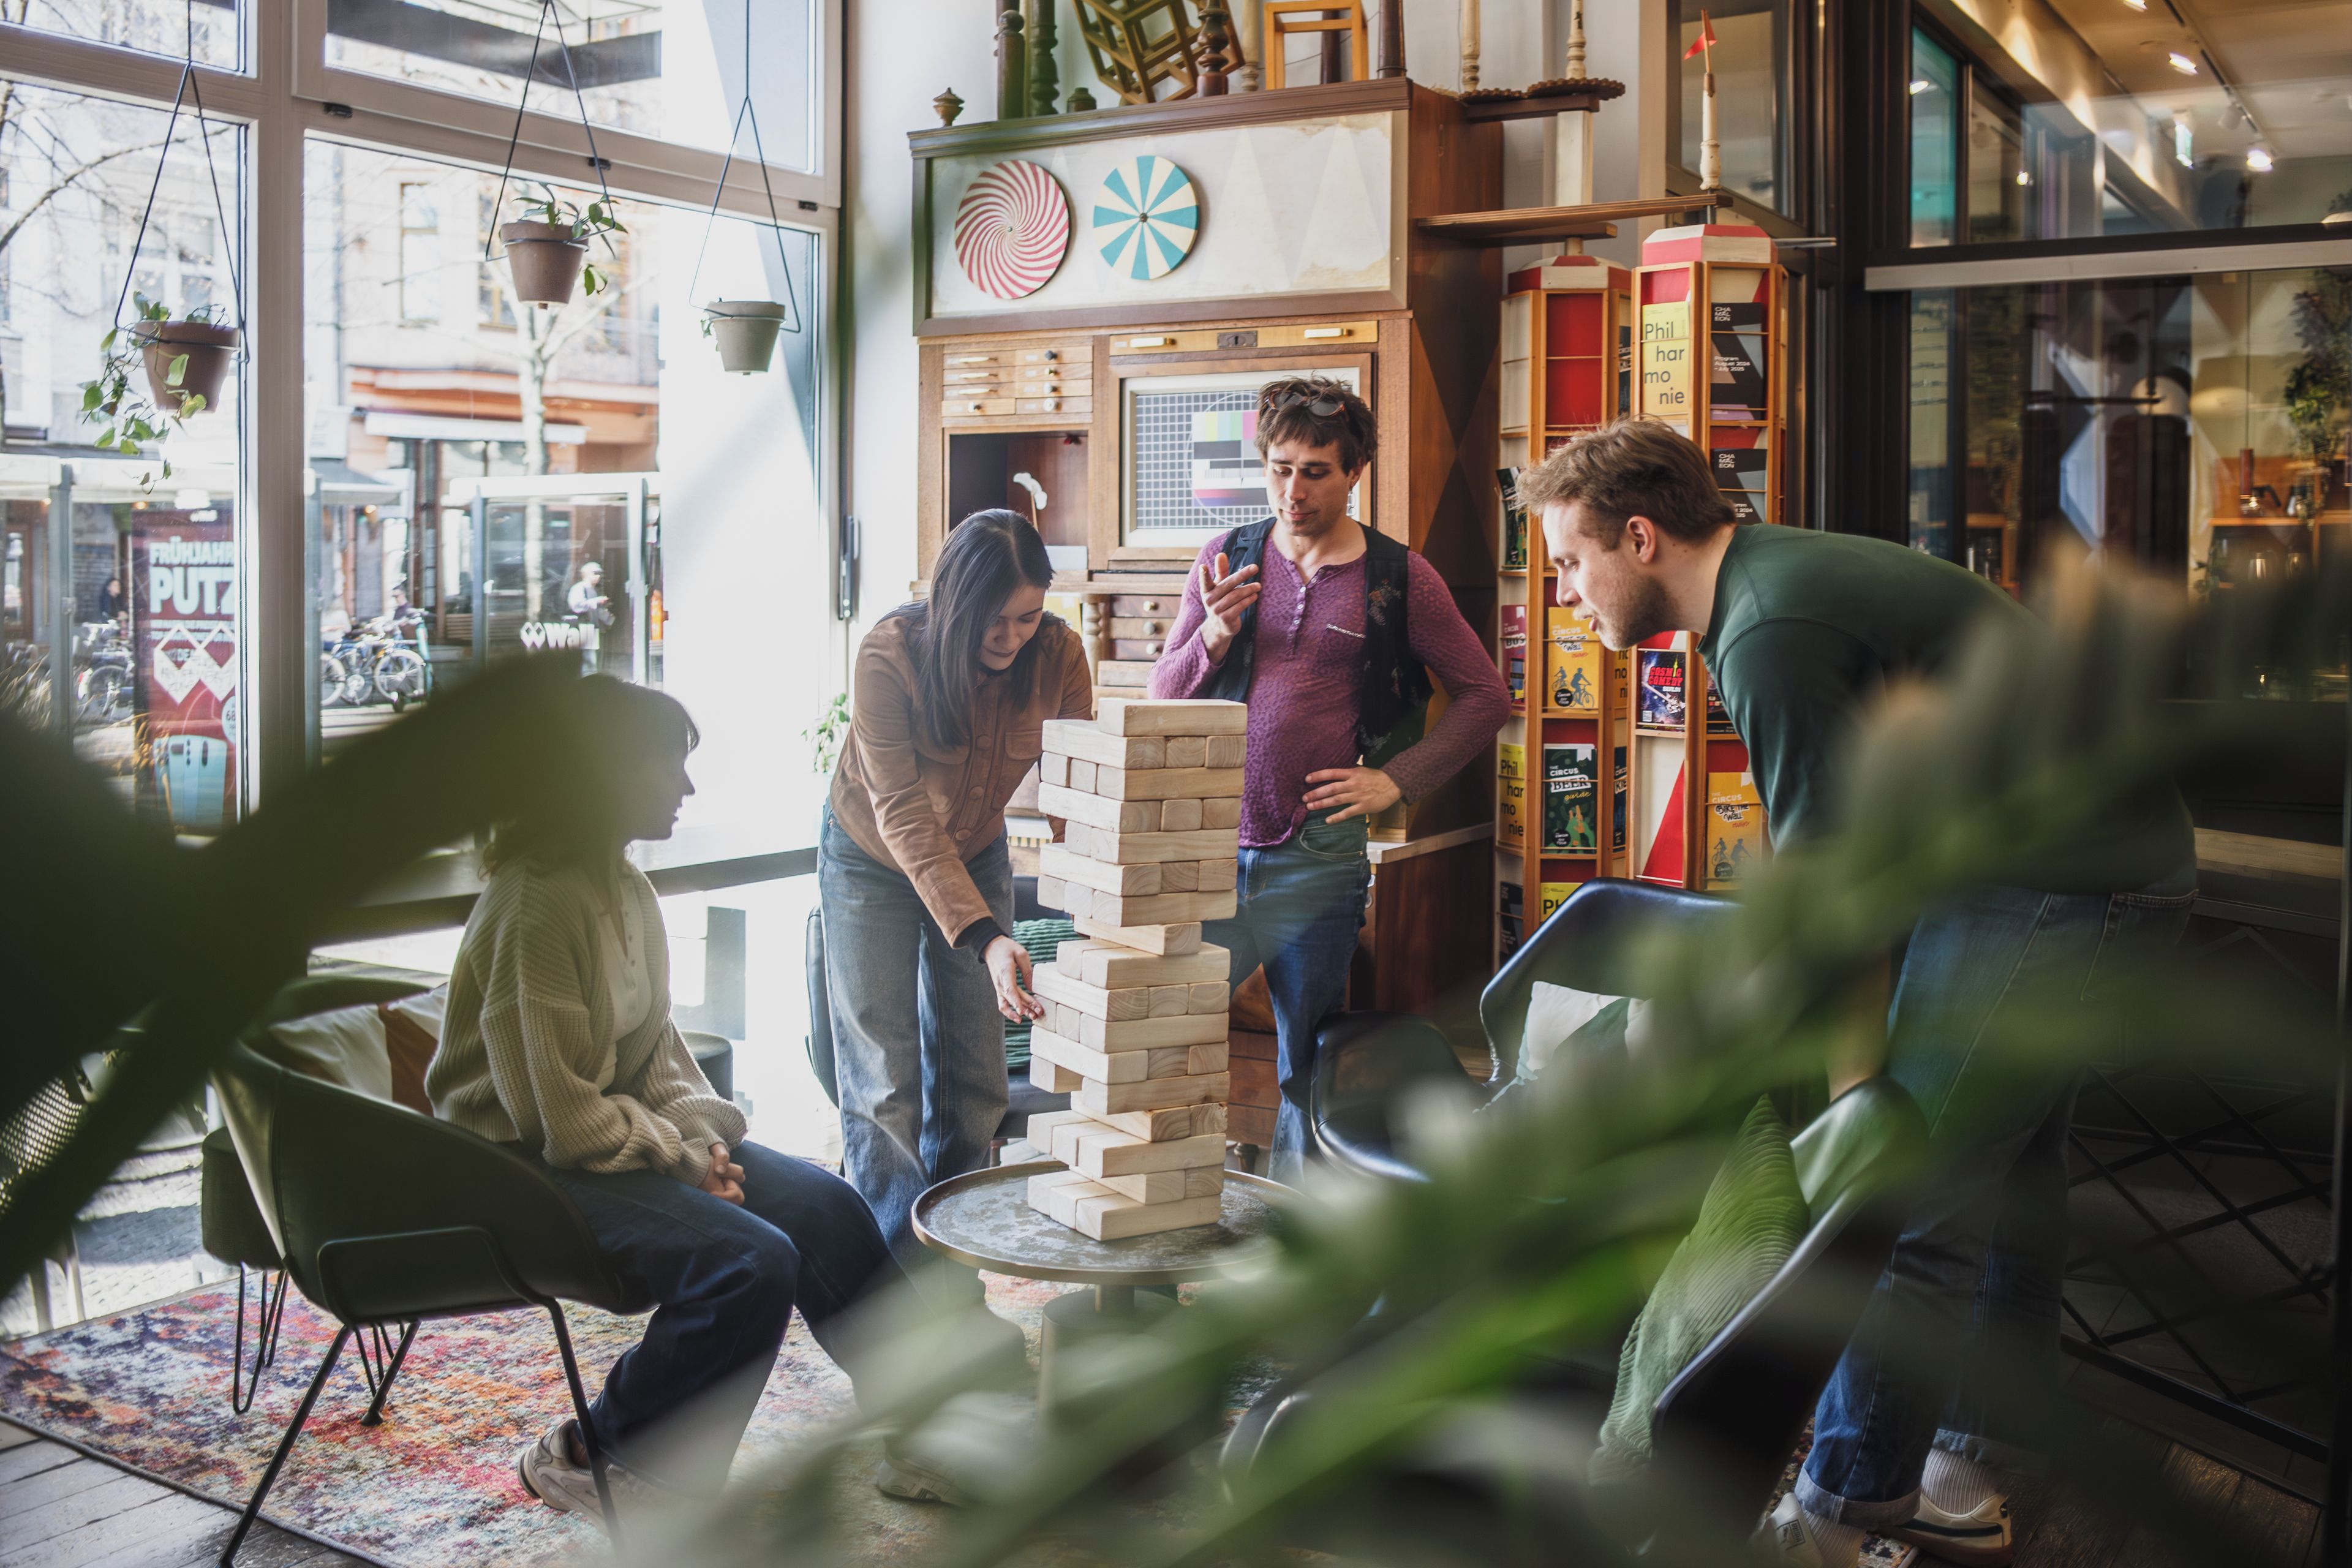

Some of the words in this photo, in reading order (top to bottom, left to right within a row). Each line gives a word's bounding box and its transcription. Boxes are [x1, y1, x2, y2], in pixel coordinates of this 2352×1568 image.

[1645, 321, 1674, 340] Phil
[1656, 345, 1685, 362] har
[1644, 370, 1671, 384] mo
[1659, 386, 1685, 405] nie
[1552, 627, 1581, 636] CIRCUS
[1649, 665, 1683, 677] COSMIC
[1648, 676, 1683, 687] COMEDY
[1501, 759, 1518, 777] Phil
[1550, 767, 1579, 777] CIRCUS
[1507, 781, 1524, 798] har
[1553, 777, 1589, 791] BEER
[1711, 794, 1743, 804] CIRCUS
[1501, 802, 1516, 816] mo
[1509, 820, 1524, 837] nie
